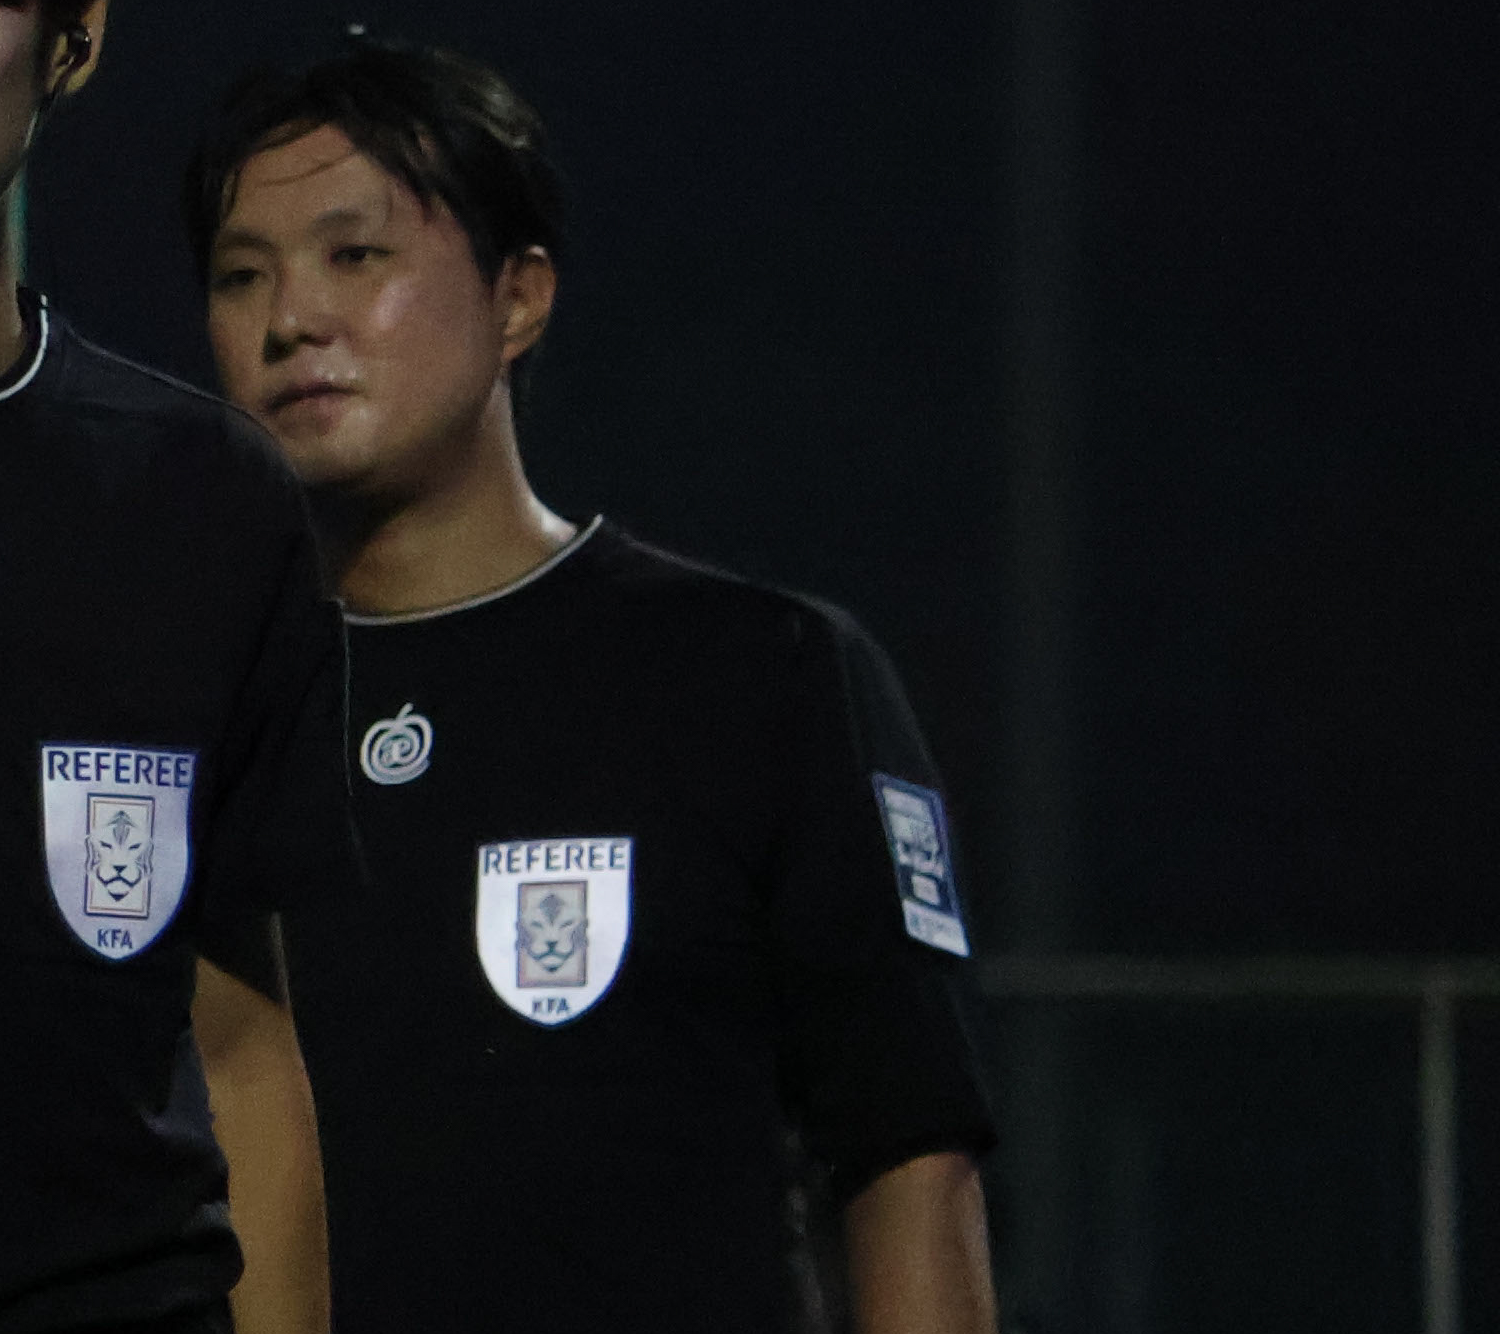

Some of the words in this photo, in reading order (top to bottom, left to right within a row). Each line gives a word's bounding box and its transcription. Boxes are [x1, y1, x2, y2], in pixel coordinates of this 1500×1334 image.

[48, 751, 189, 788] REFEREE
[484, 844, 626, 873] REFEREE
[97, 929, 133, 949] KFA
